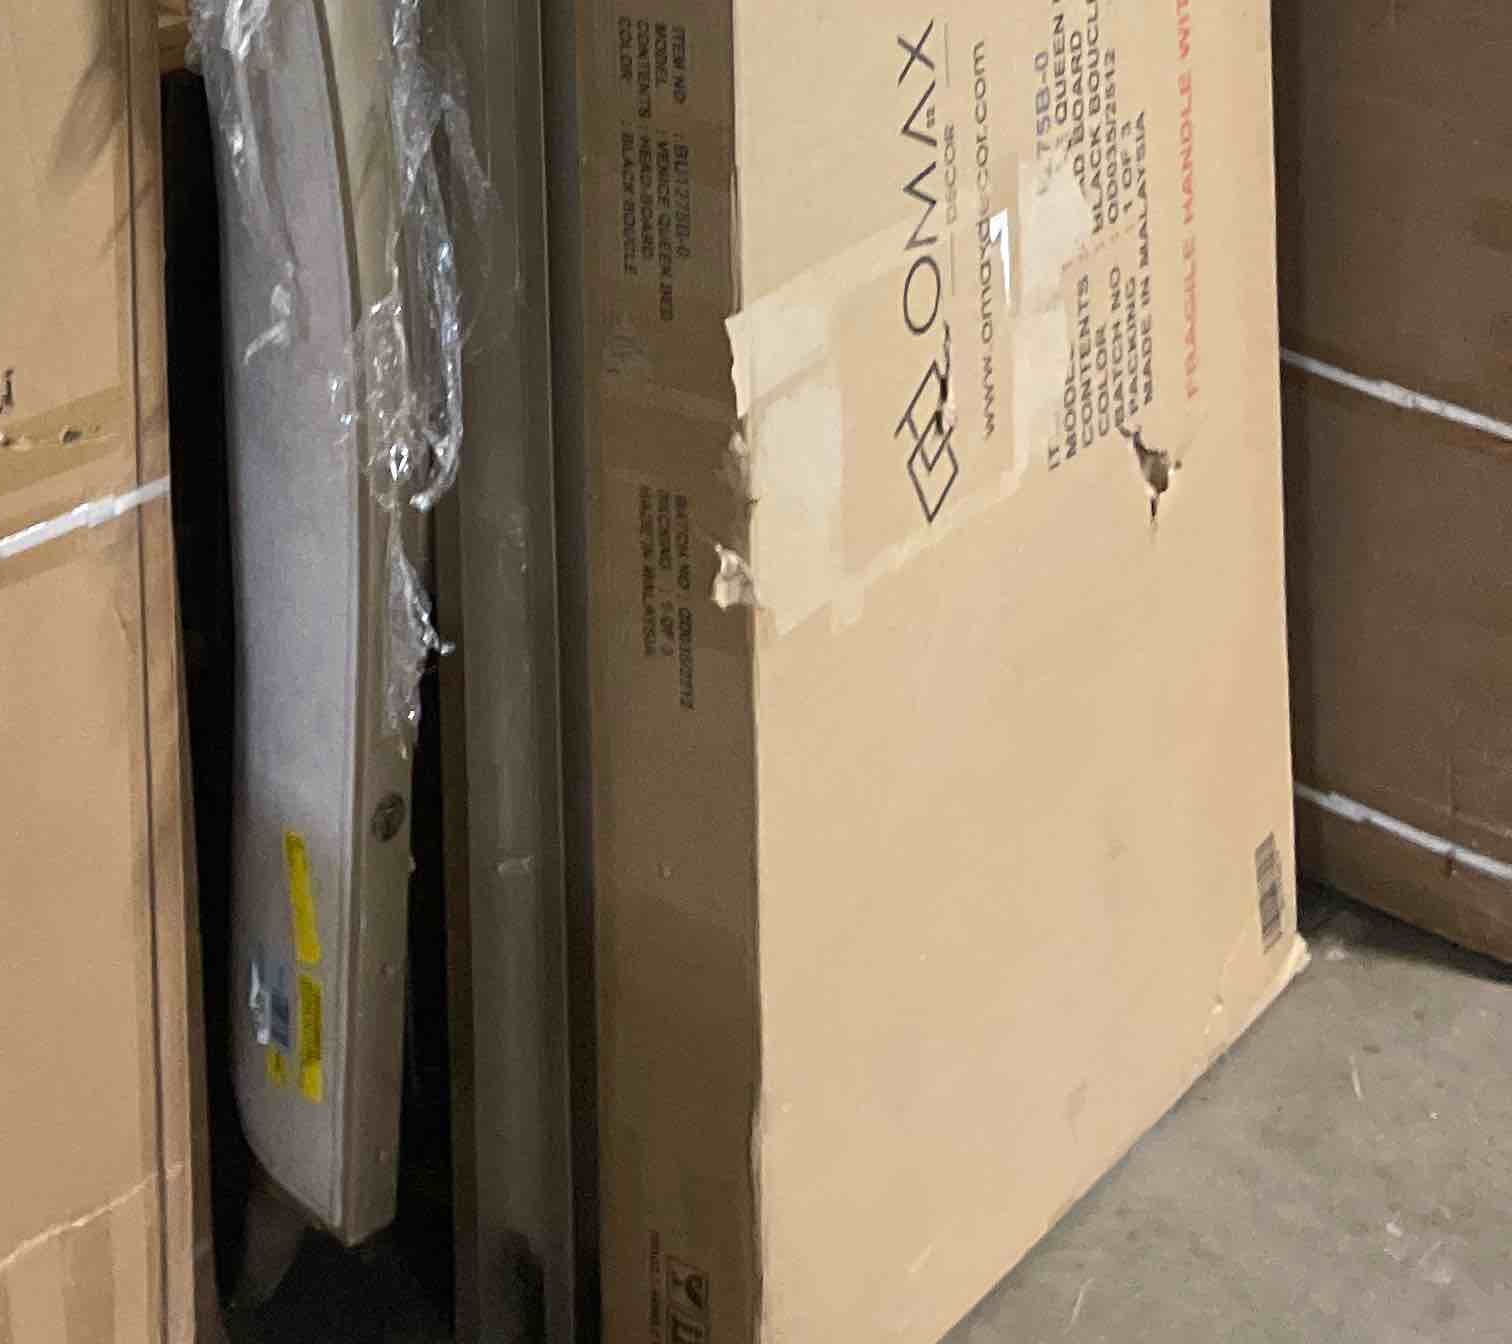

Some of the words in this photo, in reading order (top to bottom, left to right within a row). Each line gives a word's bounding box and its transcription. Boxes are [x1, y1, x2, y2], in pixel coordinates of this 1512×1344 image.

[1051, 11, 1068, 126] QUEEN
[896, 16, 942, 337] OMAX
[1121, 149, 1133, 190] OF
[1134, 109, 1151, 270] MALAYSIA
[1177, 70, 1196, 226] HANDLE
[1109, 265, 1121, 312] NO
[1124, 276, 1140, 417] PACKING
[1139, 273, 1151, 306] IN
[1180, 234, 1199, 401] FRAGILE
[1077, 272, 1093, 448] CONTENTS
[1094, 320, 1110, 437] COLOR
[1140, 313, 1153, 405] MADE
